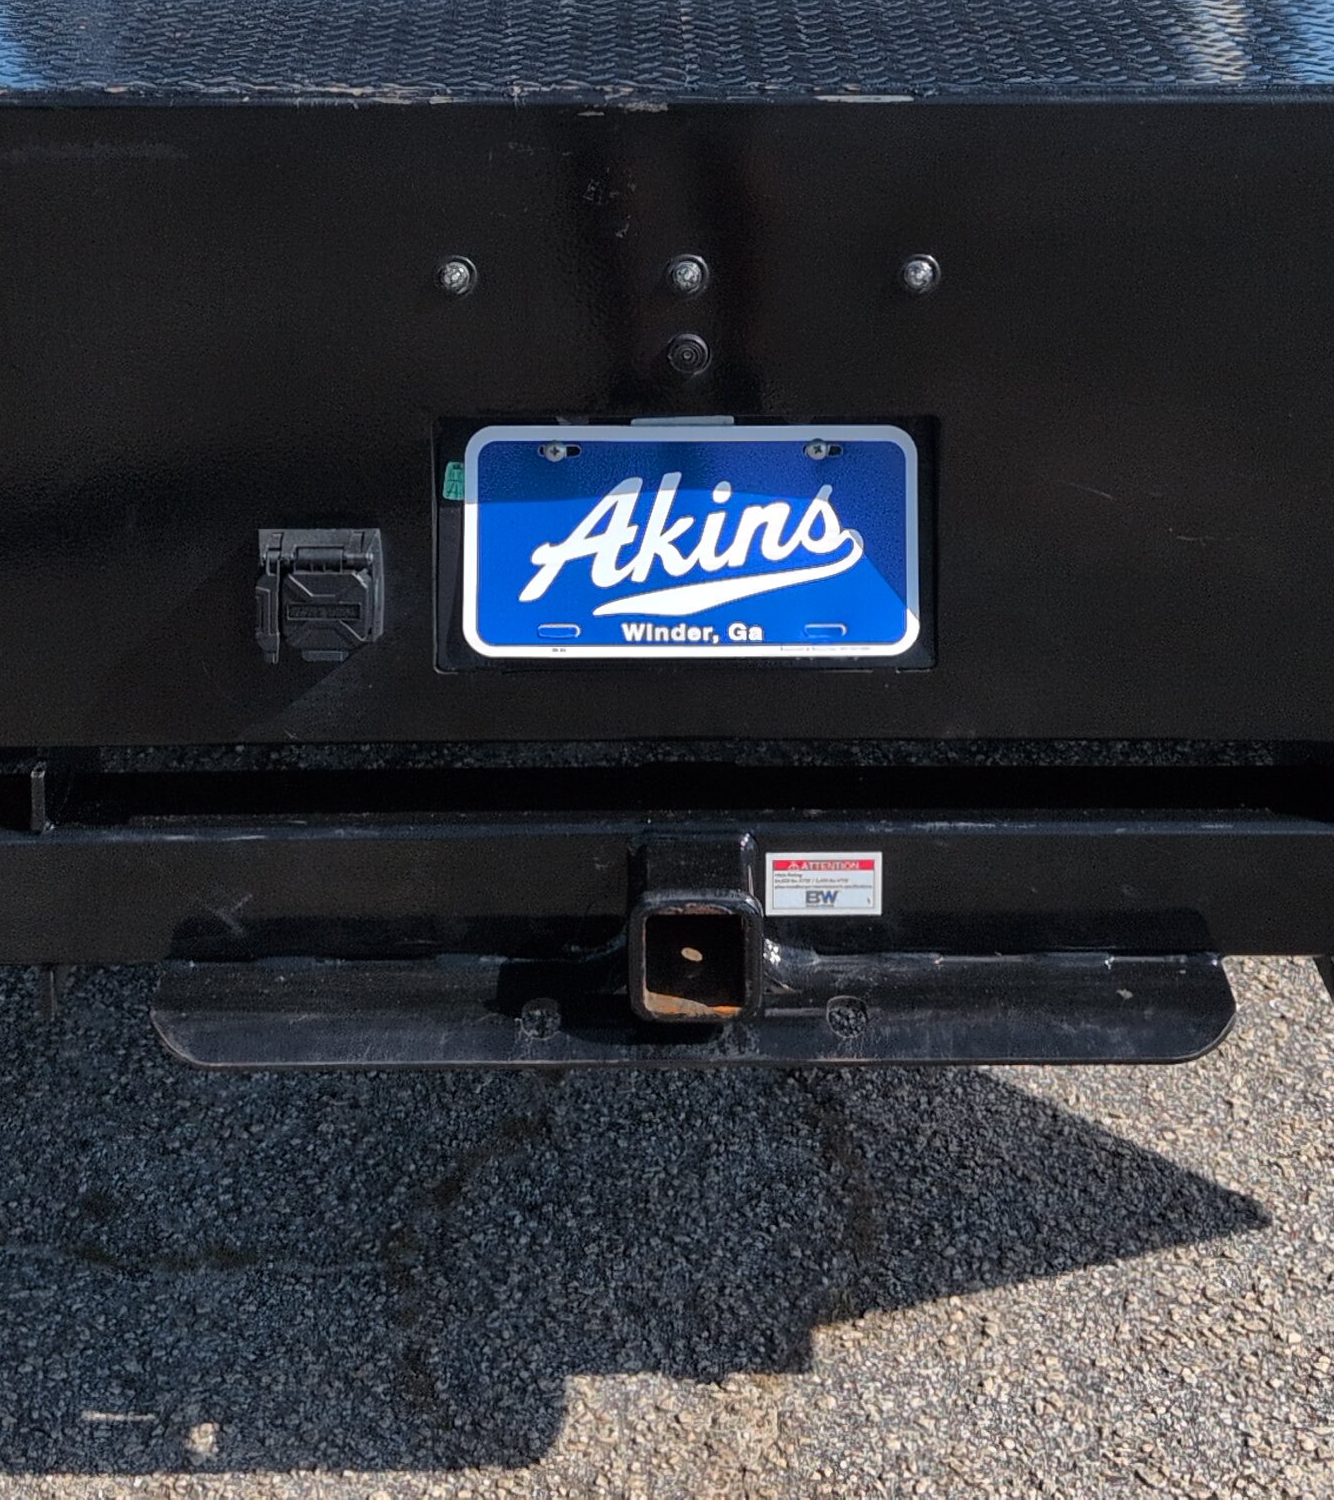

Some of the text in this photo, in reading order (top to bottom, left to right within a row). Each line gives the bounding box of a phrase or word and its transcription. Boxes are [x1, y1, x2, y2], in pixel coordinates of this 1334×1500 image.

[519, 471, 864, 602] Akins
[620, 621, 763, 644] Winder, Ga
[800, 861, 860, 870] ATTENTION
